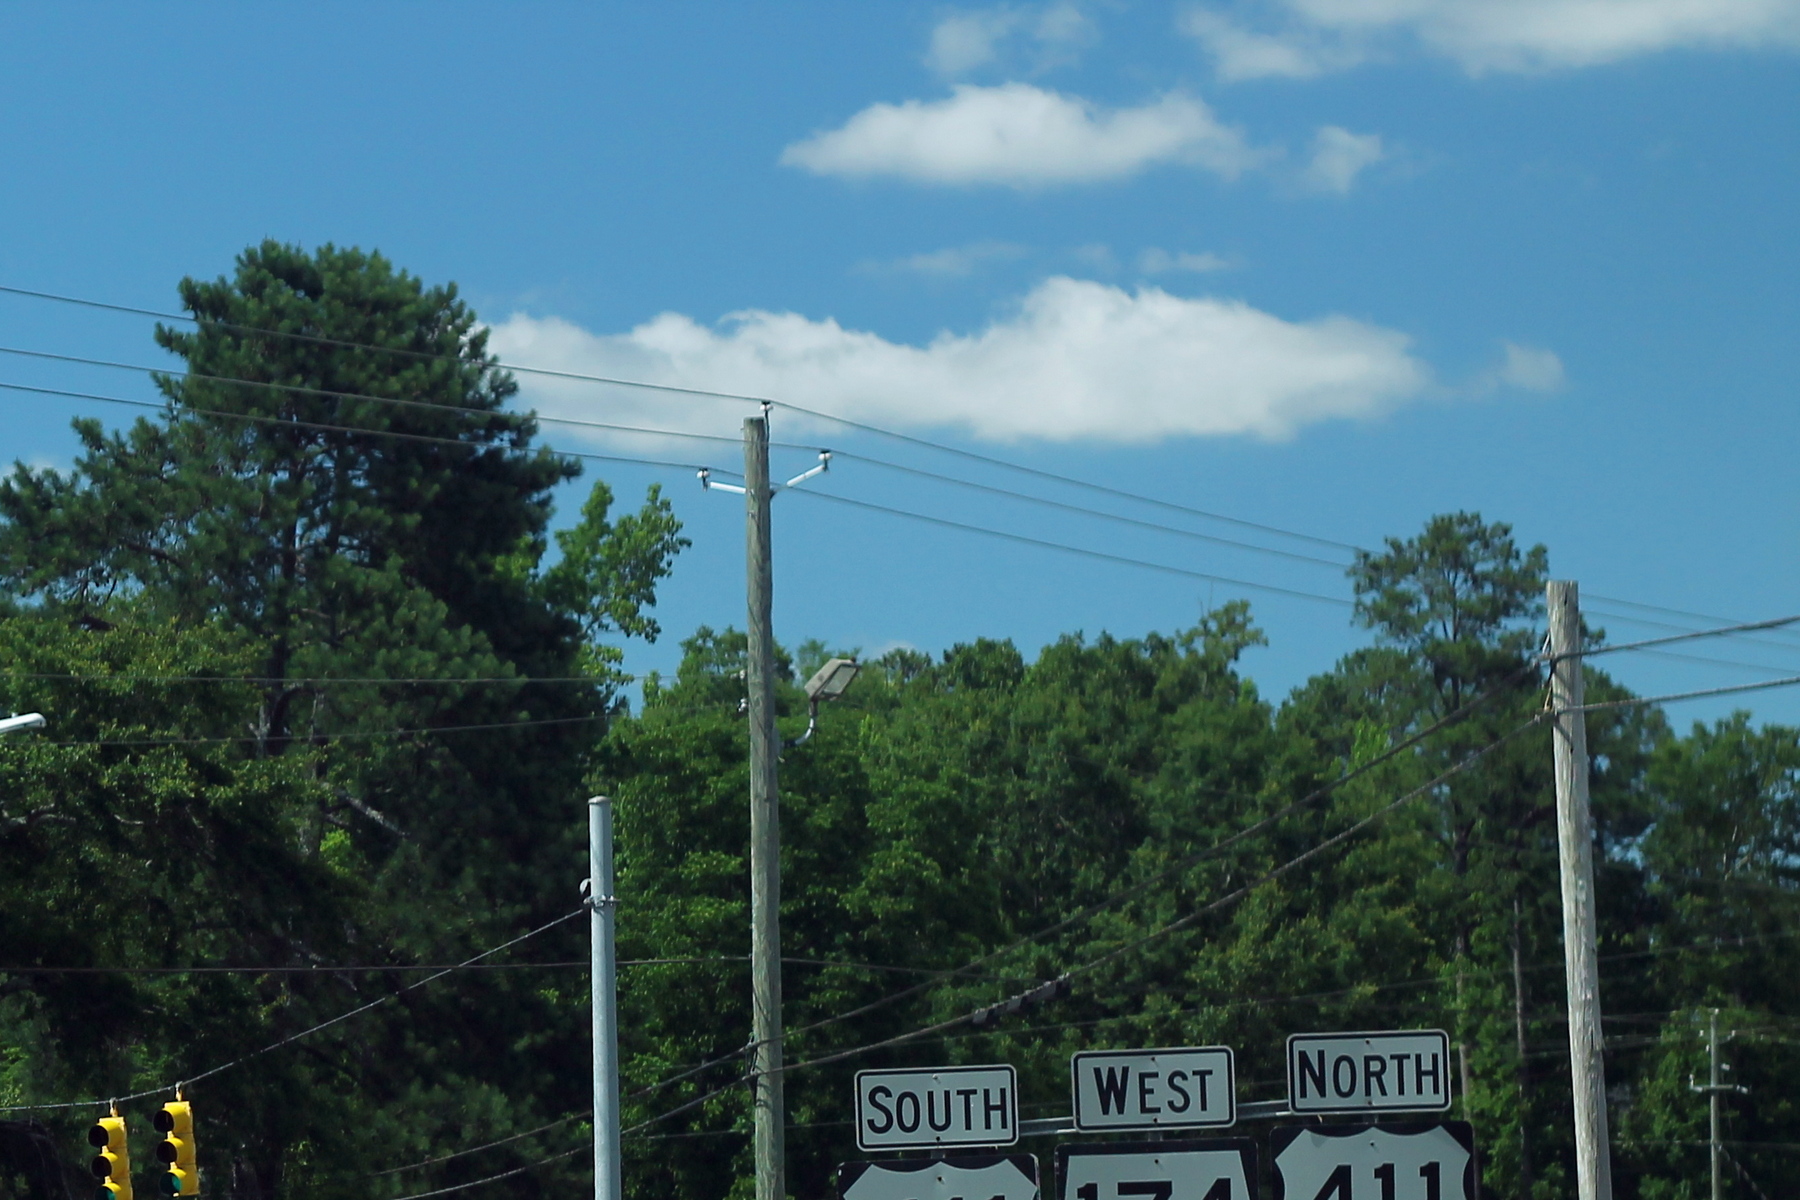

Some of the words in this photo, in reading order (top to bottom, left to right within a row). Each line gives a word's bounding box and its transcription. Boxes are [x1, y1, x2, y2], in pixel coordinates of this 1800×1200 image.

[1093, 1066, 1213, 1116] WEST
[1299, 1049, 1441, 1099] NORTH
[867, 1084, 1008, 1134] SOUTH
